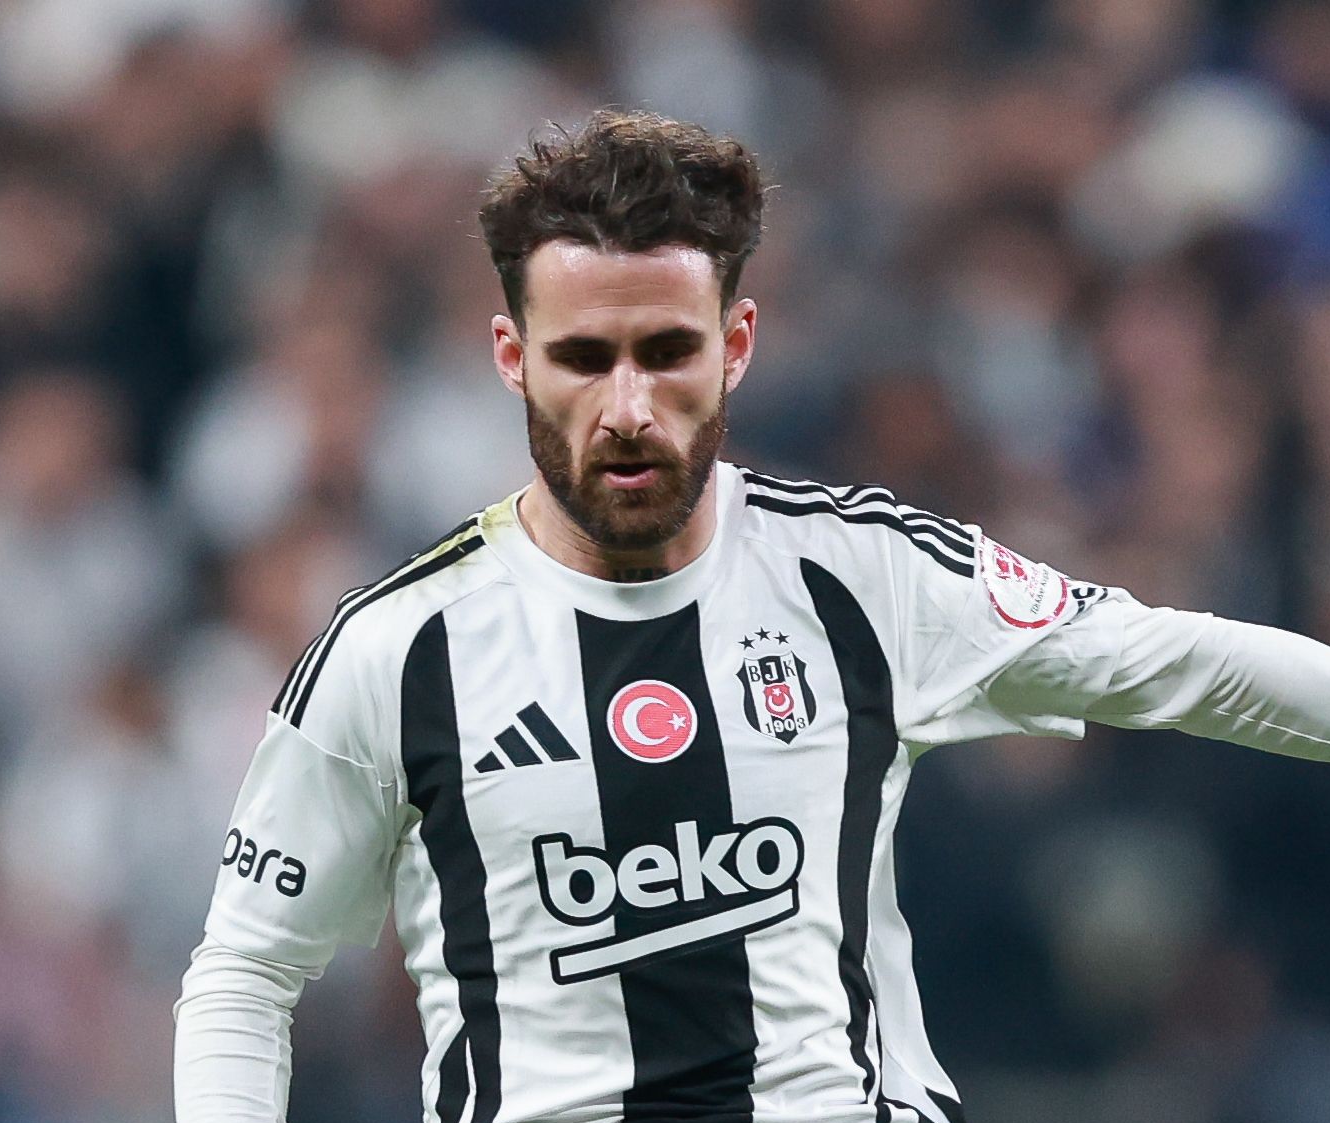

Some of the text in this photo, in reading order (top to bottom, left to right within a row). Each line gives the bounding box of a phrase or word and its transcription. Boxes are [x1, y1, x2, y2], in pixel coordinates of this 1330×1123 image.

[748, 659, 796, 682] BJK
[765, 717, 806, 734] 1903
[541, 820, 799, 918] beko
